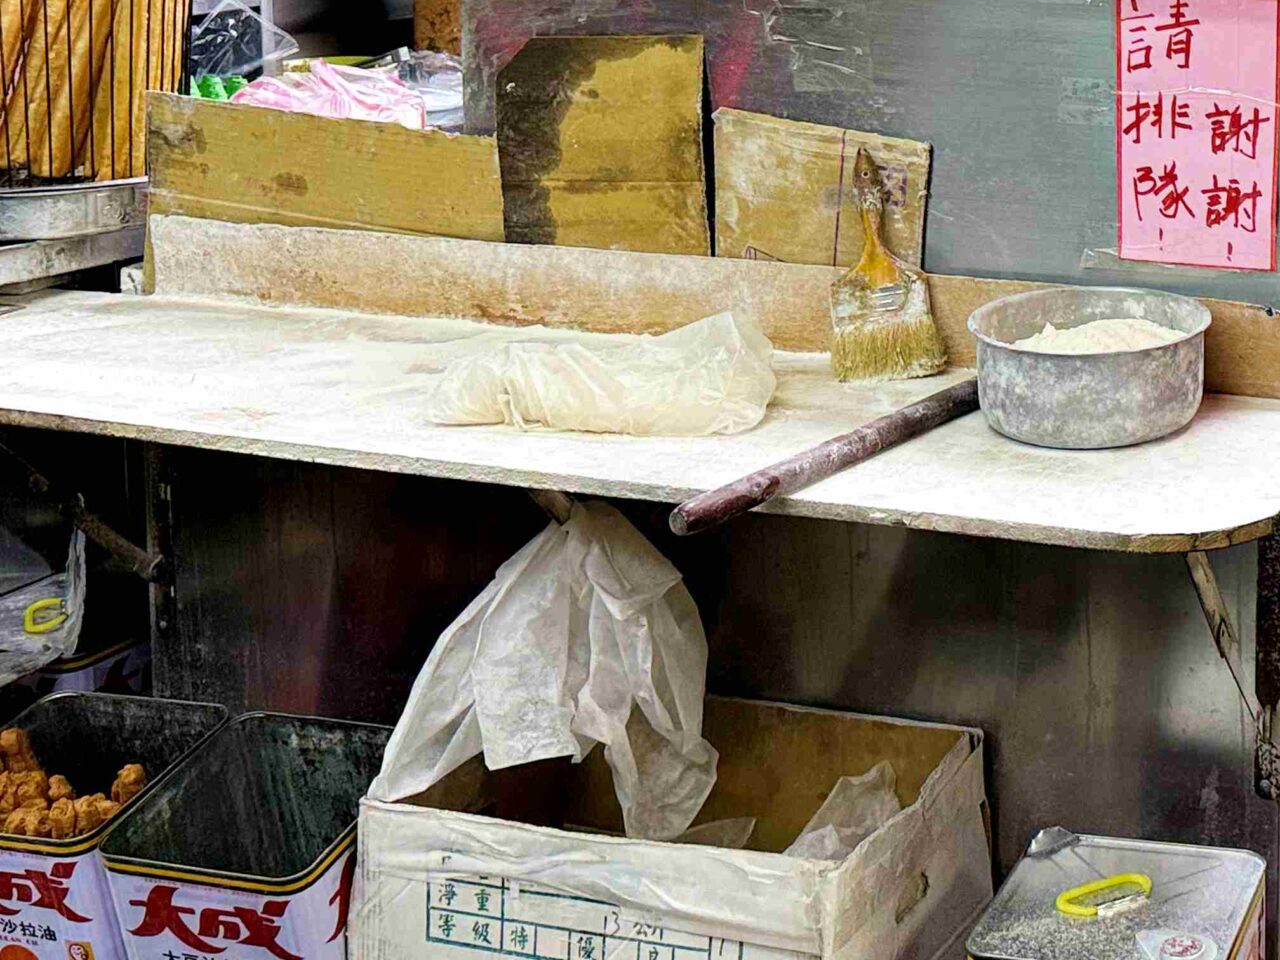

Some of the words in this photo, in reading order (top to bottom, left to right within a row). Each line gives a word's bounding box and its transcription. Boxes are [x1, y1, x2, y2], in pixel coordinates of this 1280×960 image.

[0, 860, 94, 923] 成
[438, 882, 492, 912] 淨重
[126, 884, 305, 960] 大成
[438, 912, 493, 946] 等級
[510, 924, 529, 951] 特
